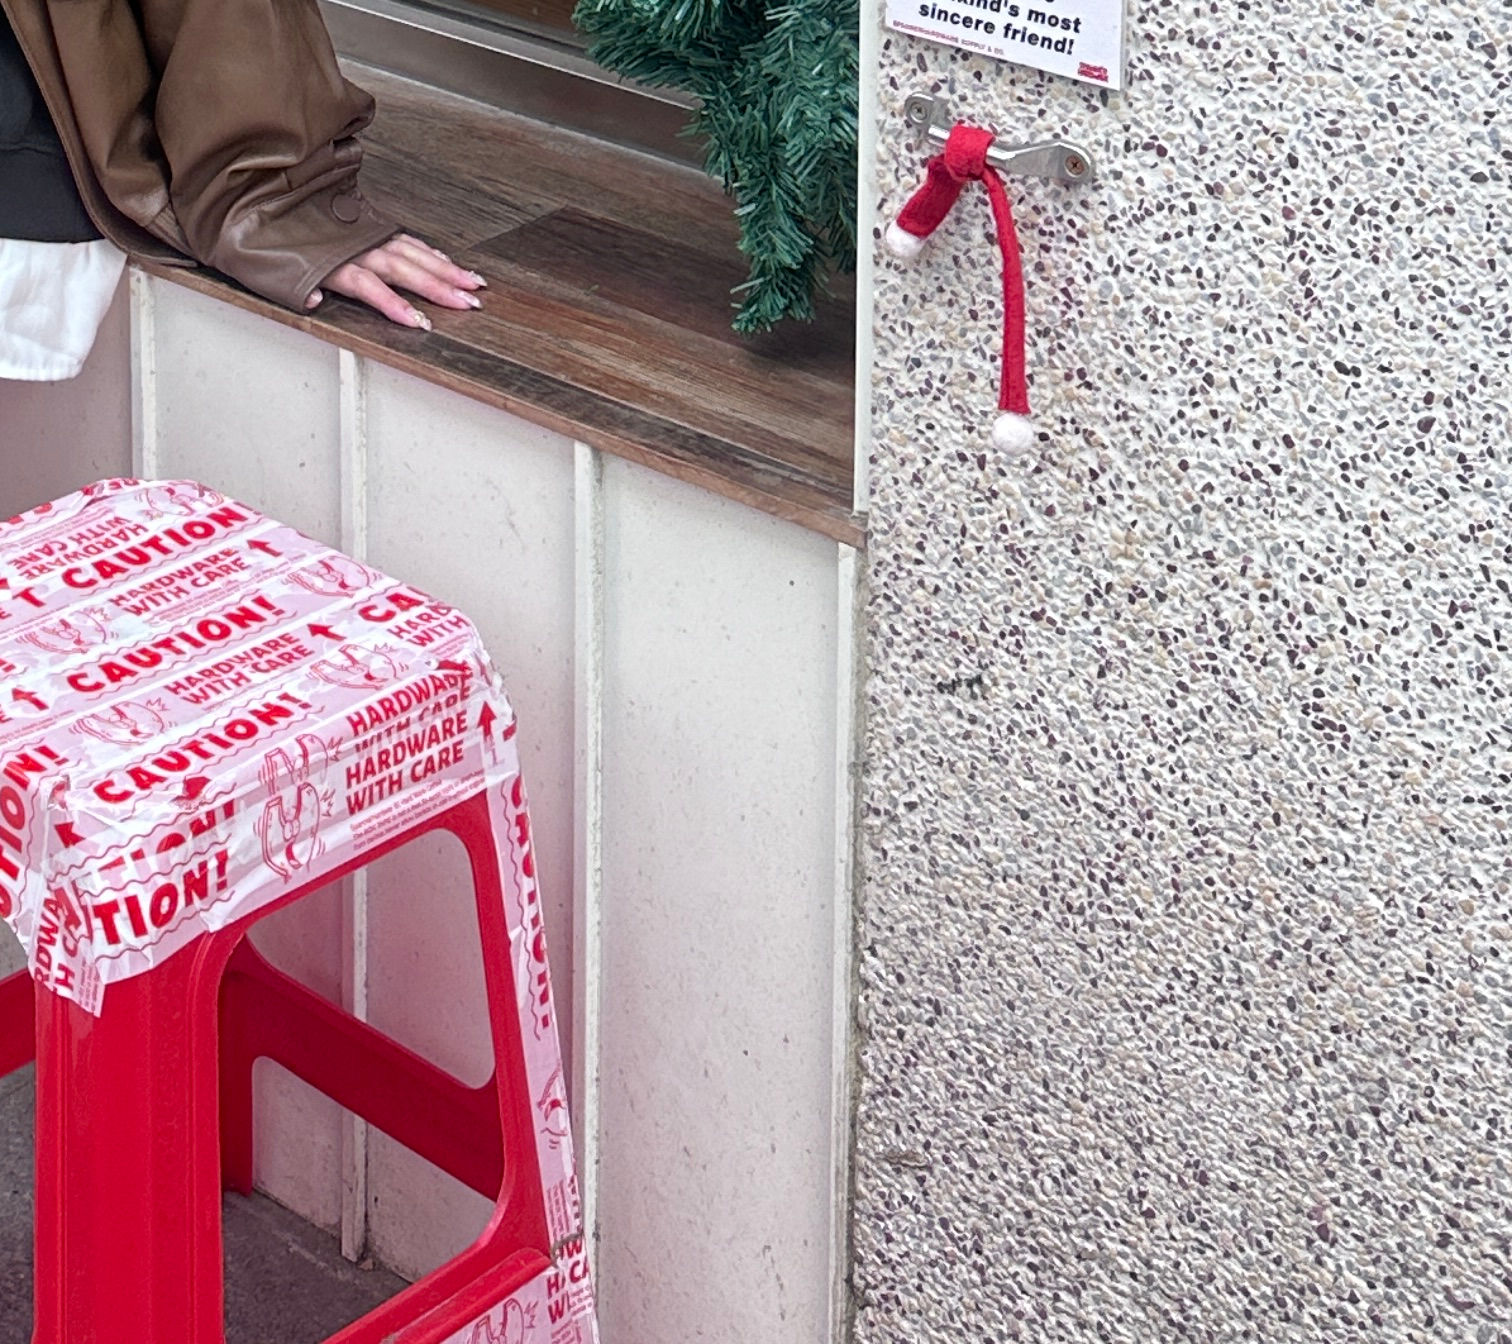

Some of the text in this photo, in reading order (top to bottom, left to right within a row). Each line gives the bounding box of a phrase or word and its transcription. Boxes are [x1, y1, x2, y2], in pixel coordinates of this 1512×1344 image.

[919, 2, 996, 35] sincere
[1004, 22, 1075, 56] friend!
[1027, 9, 1082, 34] most
[7, 515, 132, 570] WITH CARE
[18, 523, 149, 580] HARDWARE
[61, 506, 249, 589] CAUTION
[108, 548, 240, 608] HARDWARE
[123, 556, 252, 617] WITH CARE
[66, 595, 285, 693] CAUTION!
[164, 632, 301, 696] HARDWARE
[181, 644, 315, 705] WITH CARE
[93, 692, 312, 803] CAUTION!
[345, 709, 467, 789] HARDWARE
[345, 771, 403, 816] WITH
[410, 739, 464, 783] CARE
